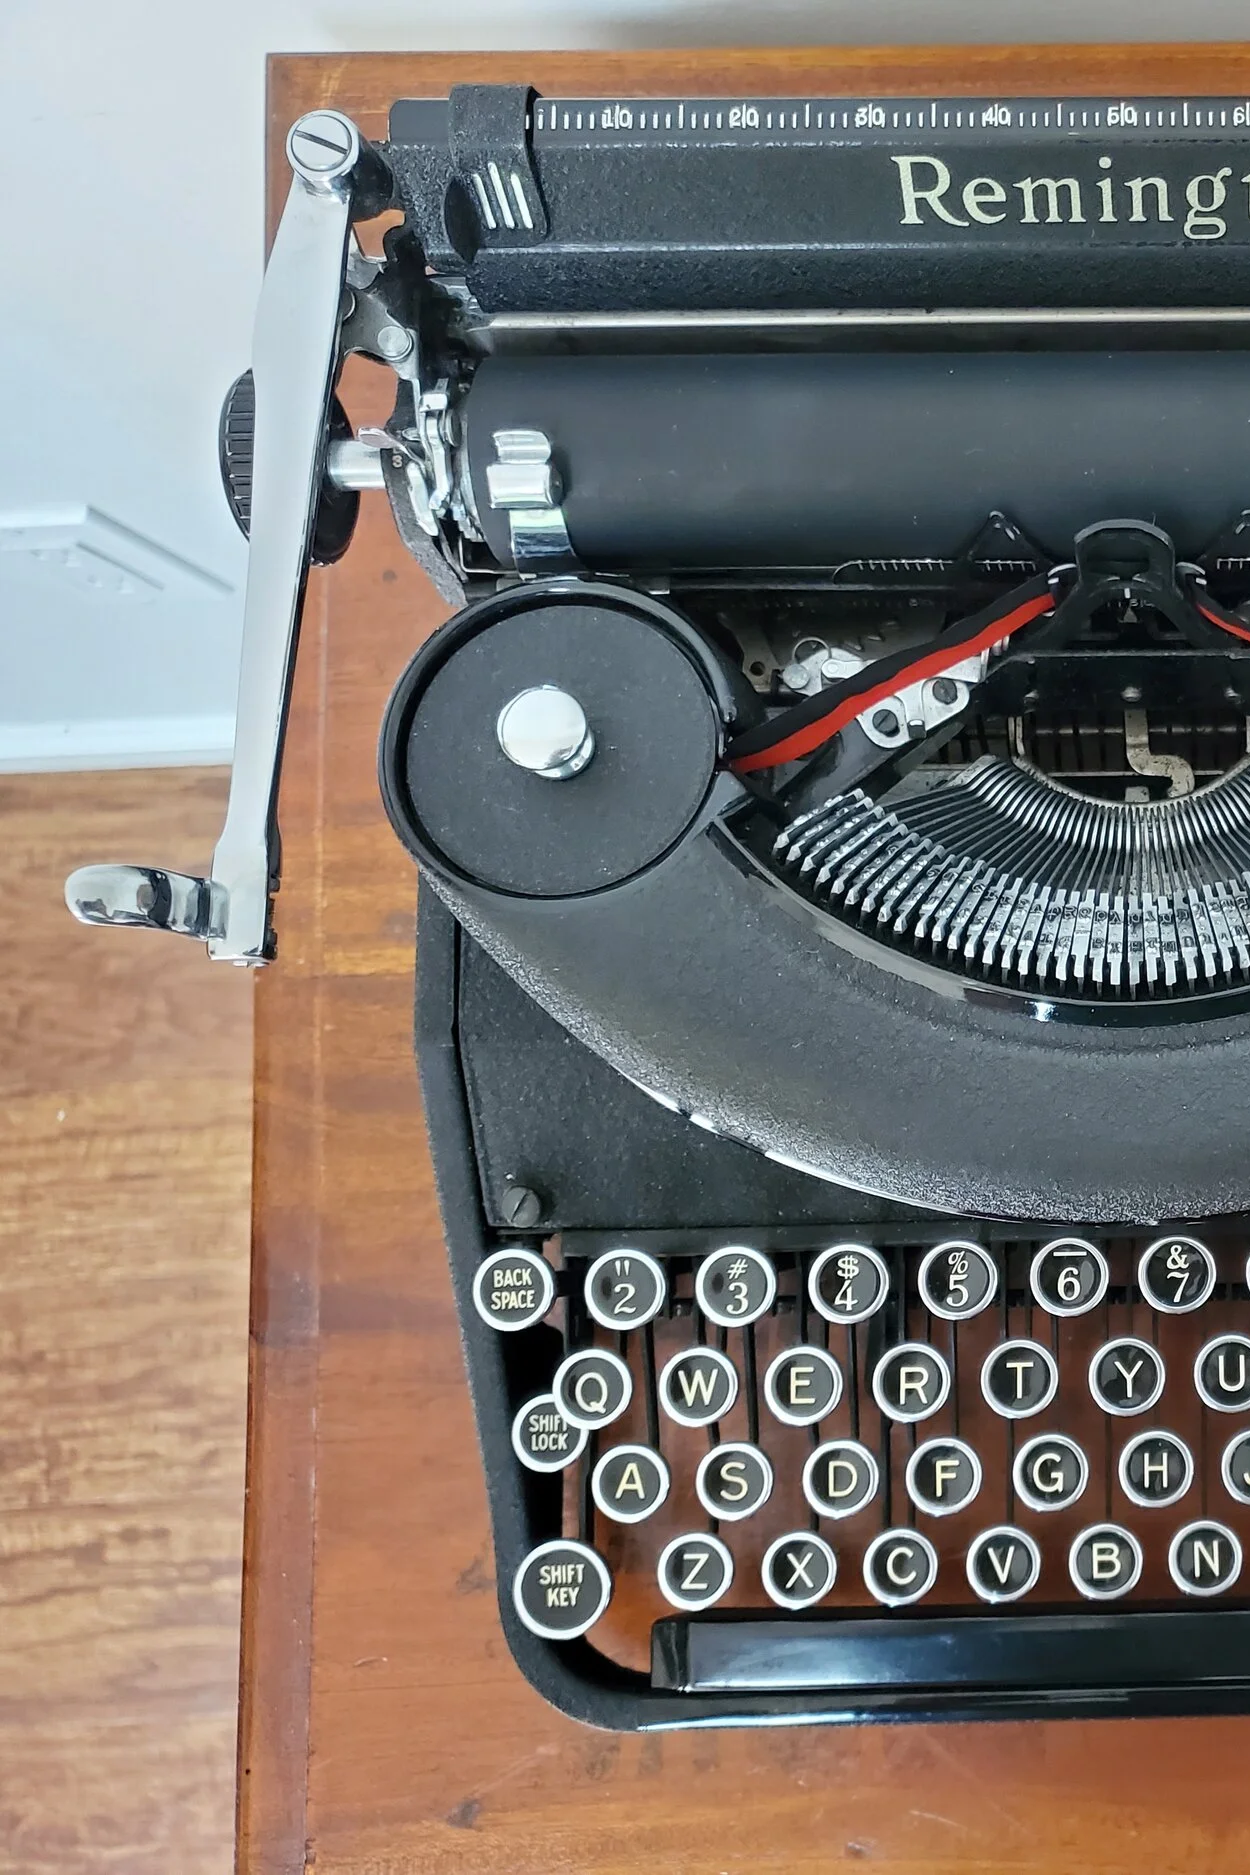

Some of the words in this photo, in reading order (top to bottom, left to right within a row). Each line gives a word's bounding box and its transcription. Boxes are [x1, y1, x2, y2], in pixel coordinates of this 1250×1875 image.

[727, 1258, 748, 1280] #
[837, 1254, 860, 1280] $
[947, 1250, 969, 1275] %
[1166, 1244, 1190, 1270] &
[493, 1267, 533, 1288] BACK
[834, 1279, 859, 1312] 4
[946, 1273, 969, 1307] 5
[1057, 1266, 1081, 1301] 6
[1167, 1272, 1190, 1304] 7
[490, 1289, 535, 1310] SPACE
[613, 1283, 637, 1315] 2
[726, 1281, 749, 1315] 3
[677, 1368, 719, 1407] W
[790, 1366, 816, 1405] E
[899, 1366, 929, 1405] R
[1006, 1360, 1034, 1399] T
[1113, 1360, 1144, 1398] Y
[1218, 1354, 1246, 1392] U
[575, 1371, 608, 1414] Q
[530, 1434, 569, 1451] LOCK
[615, 1462, 645, 1499] A
[720, 1461, 749, 1501] S
[828, 1460, 858, 1497] D
[935, 1459, 960, 1497] F
[1032, 1453, 1064, 1493] G
[1143, 1452, 1168, 1488] H
[539, 1563, 585, 1585] SHIFT
[680, 1552, 710, 1590] Z
[785, 1551, 814, 1589] X
[886, 1546, 917, 1585] C
[987, 1545, 1015, 1584] V
[1092, 1542, 1122, 1579] B
[1193, 1539, 1220, 1578] N
[547, 1586, 580, 1608] KEY
